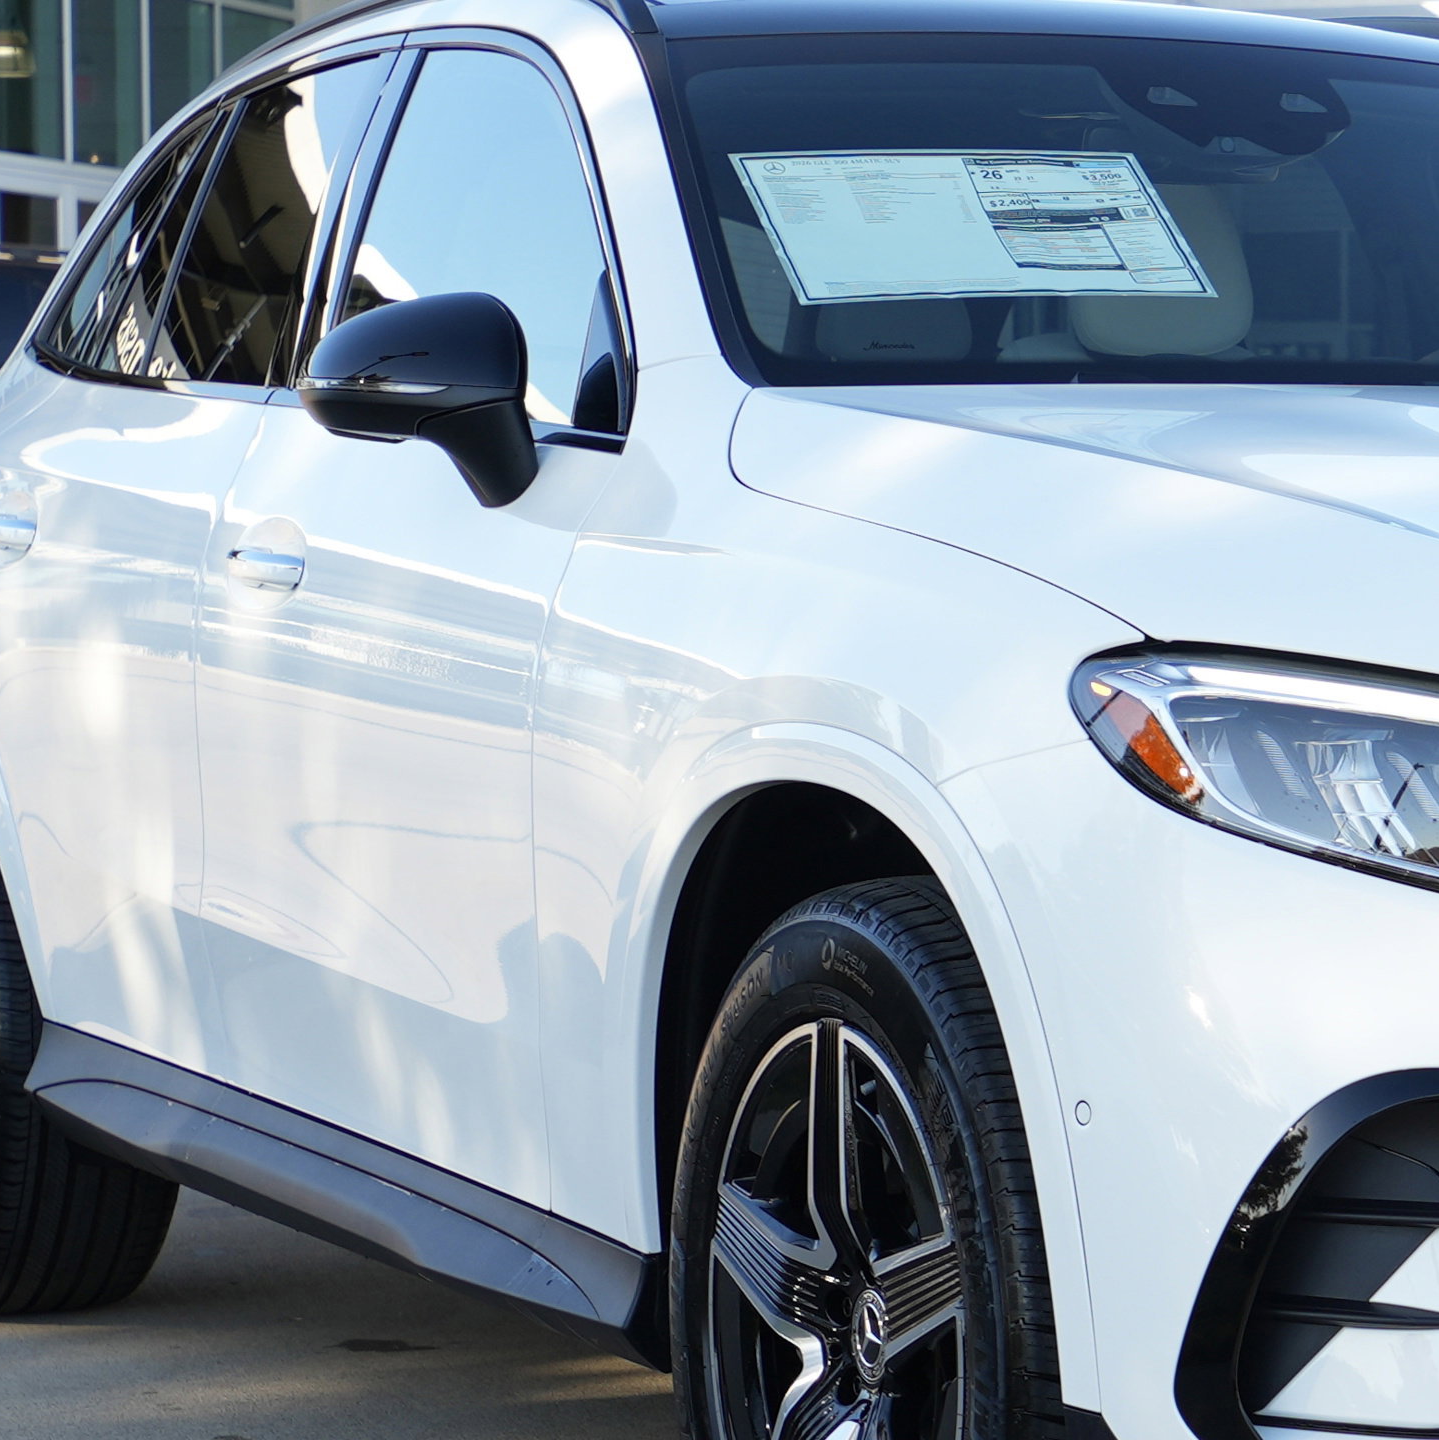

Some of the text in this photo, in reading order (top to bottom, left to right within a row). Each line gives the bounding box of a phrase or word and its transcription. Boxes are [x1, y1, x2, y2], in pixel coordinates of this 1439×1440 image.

[980, 169, 1003, 180] 26
[990, 199, 1031, 208] $2,400
[837, 946, 868, 975] MICHELIN
